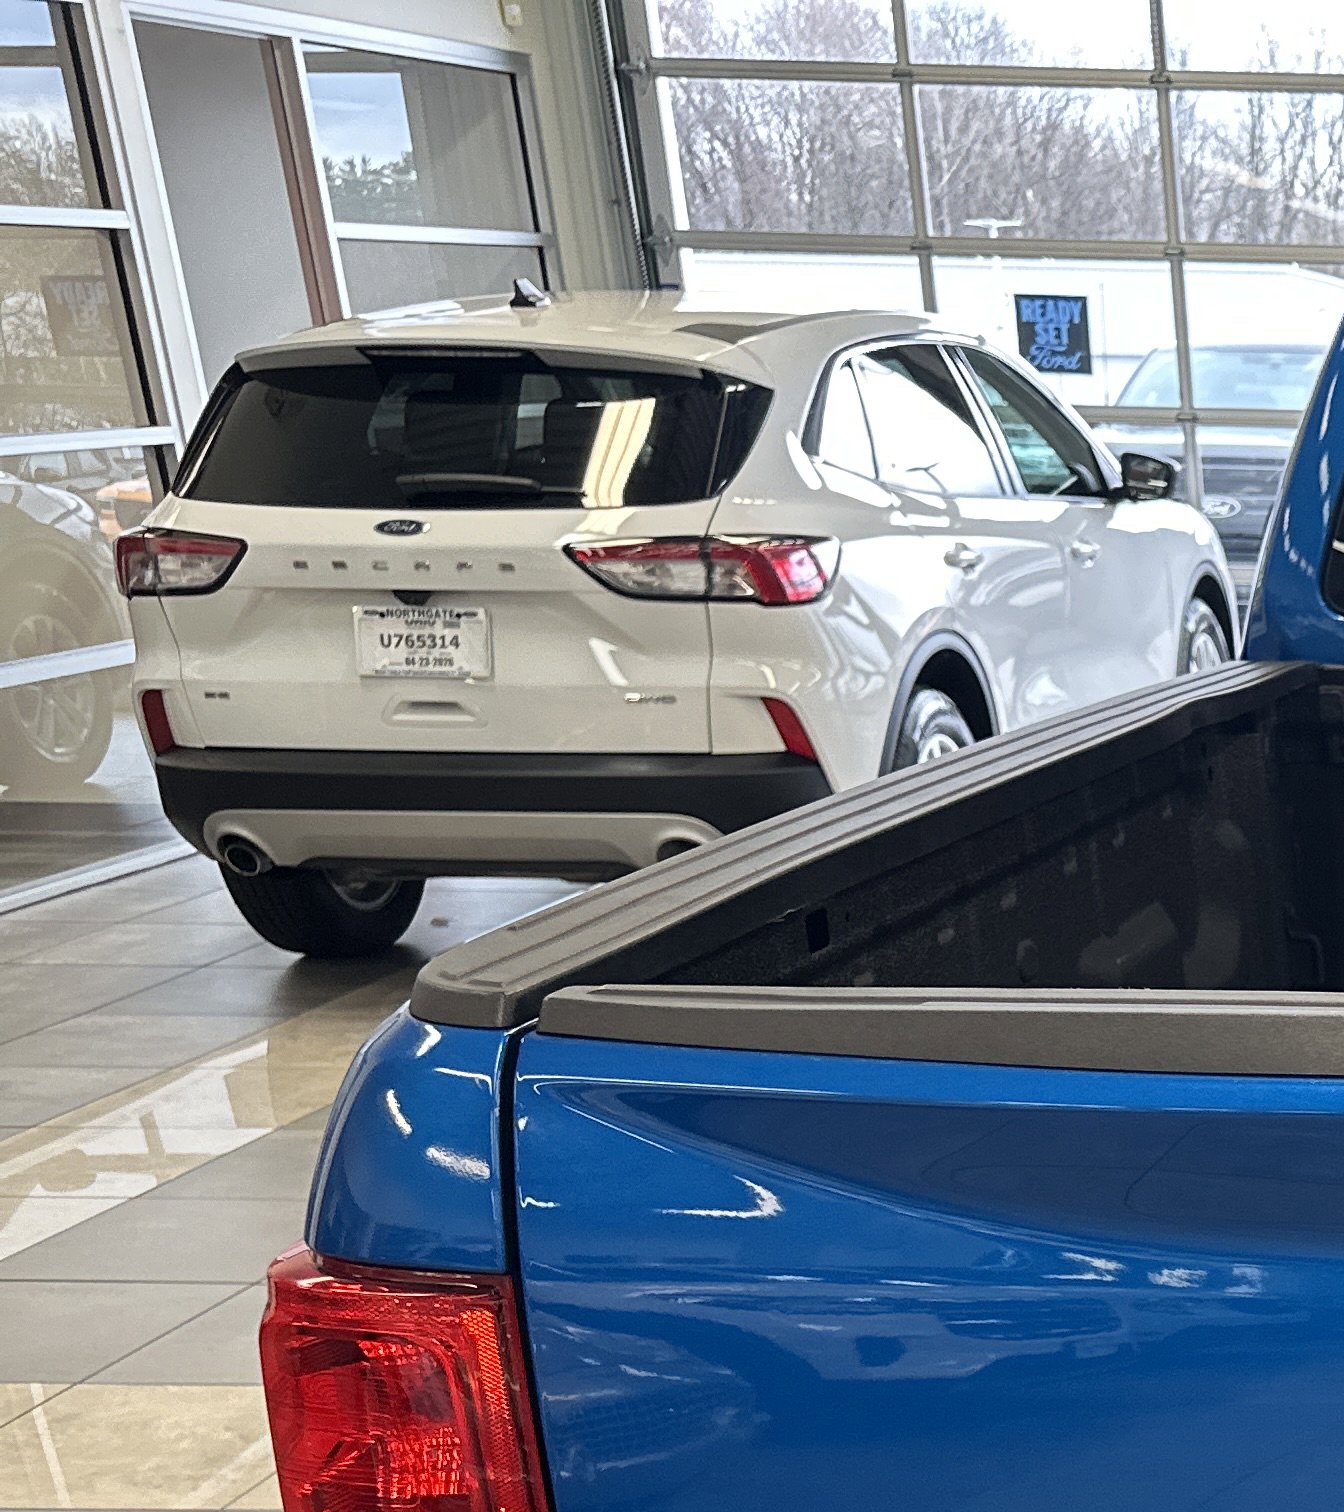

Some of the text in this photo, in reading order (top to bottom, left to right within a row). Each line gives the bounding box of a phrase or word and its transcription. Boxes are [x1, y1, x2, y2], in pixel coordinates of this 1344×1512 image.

[1020, 298, 1082, 324] READY
[1034, 323, 1070, 346] SET
[1026, 345, 1083, 370] Ford
[385, 608, 456, 619] NORTHGATE
[380, 633, 460, 650] U765314
